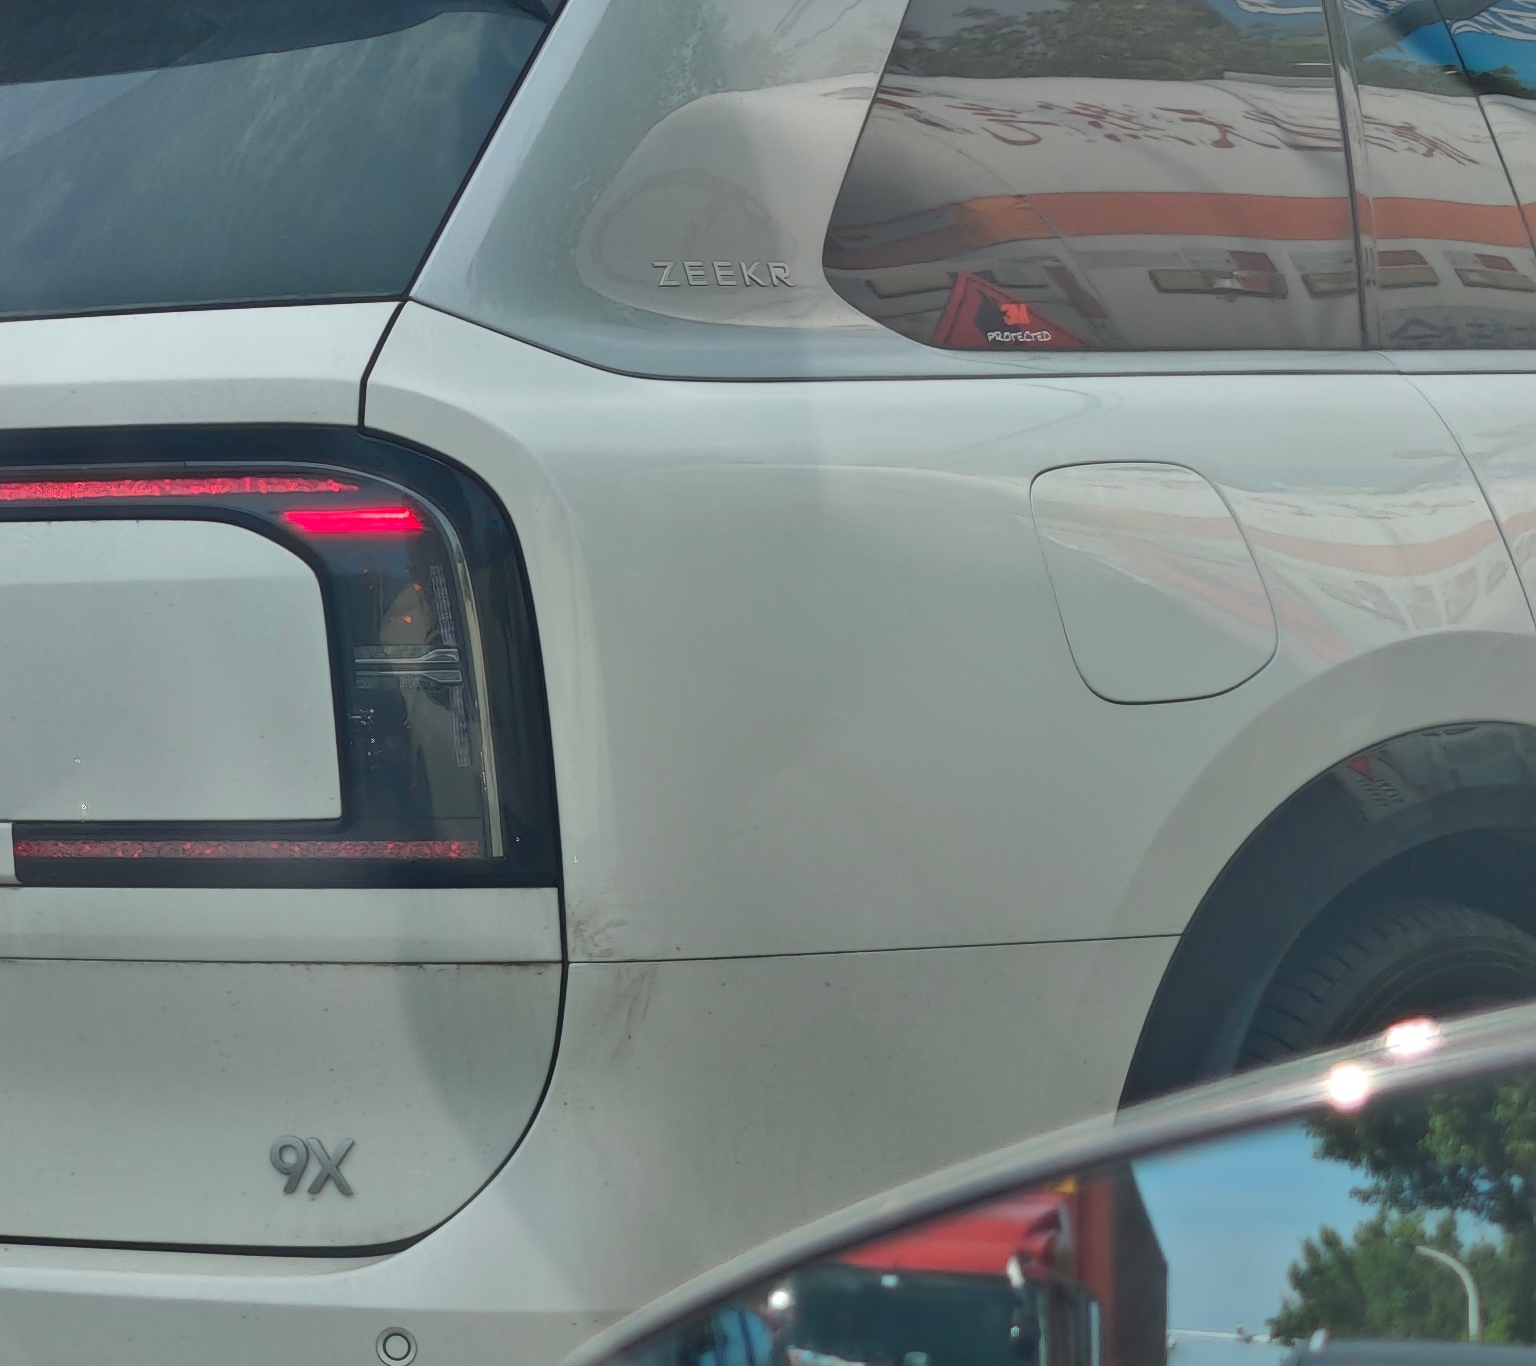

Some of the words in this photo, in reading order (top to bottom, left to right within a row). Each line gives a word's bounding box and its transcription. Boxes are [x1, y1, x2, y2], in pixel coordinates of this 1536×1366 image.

[652, 261, 795, 287] ZEEKR
[987, 331, 1052, 342] PROTECTED
[269, 1135, 355, 1196] 9X
